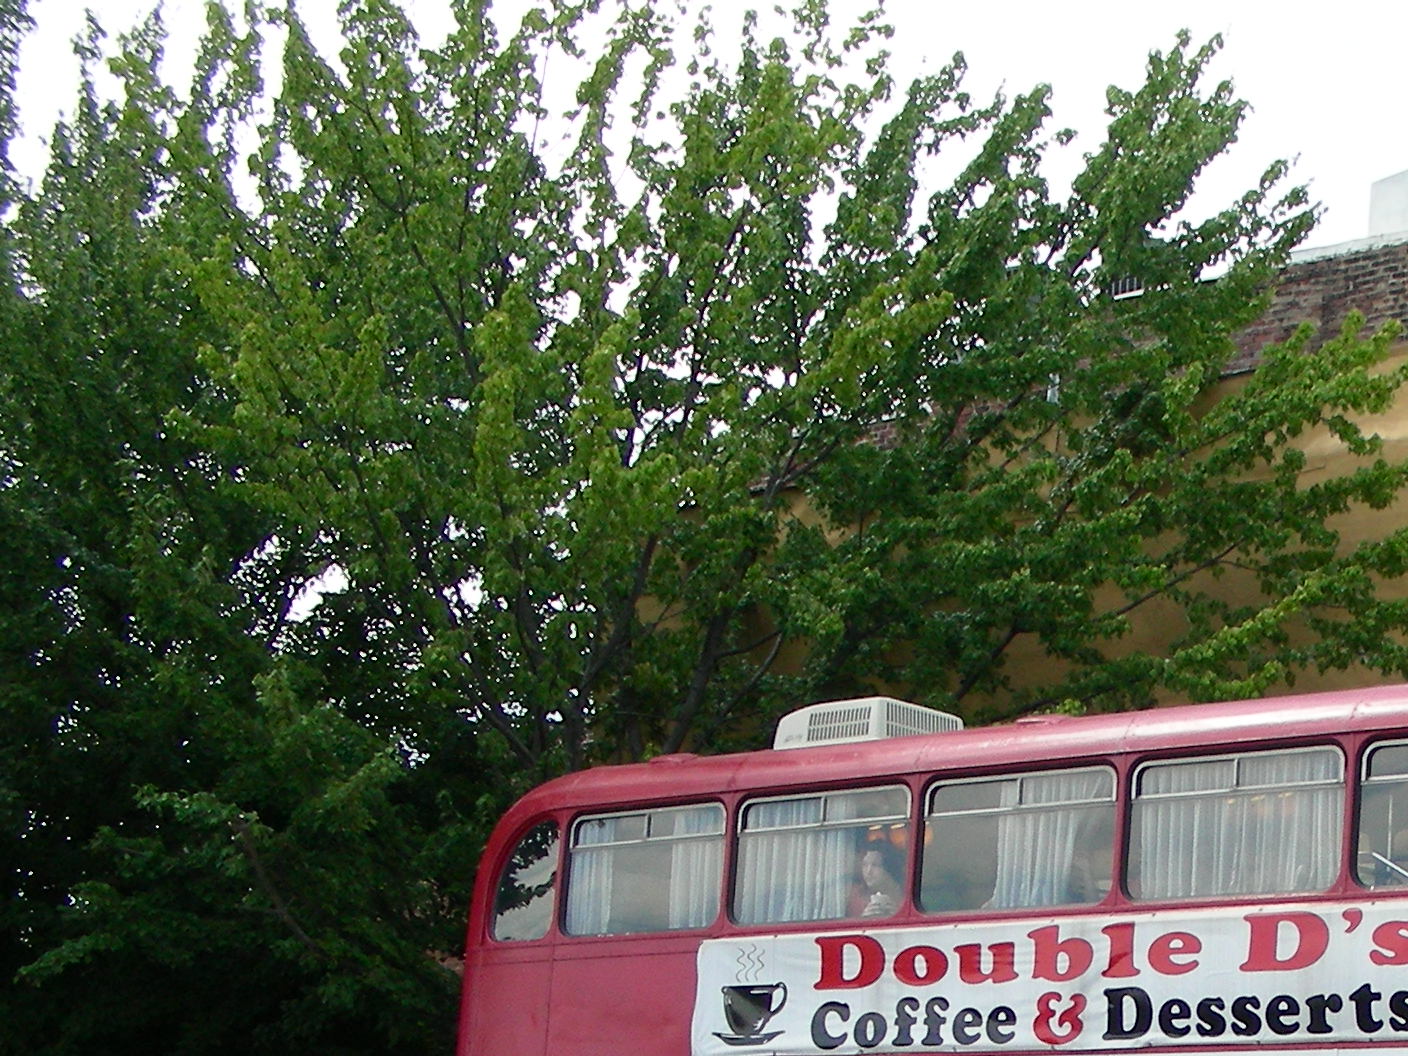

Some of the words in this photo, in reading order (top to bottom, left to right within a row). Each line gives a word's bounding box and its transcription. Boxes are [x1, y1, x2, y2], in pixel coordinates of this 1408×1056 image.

[813, 921, 1203, 990] Double
[810, 997, 1017, 1050] Coffee
[1033, 991, 1088, 1046] &
